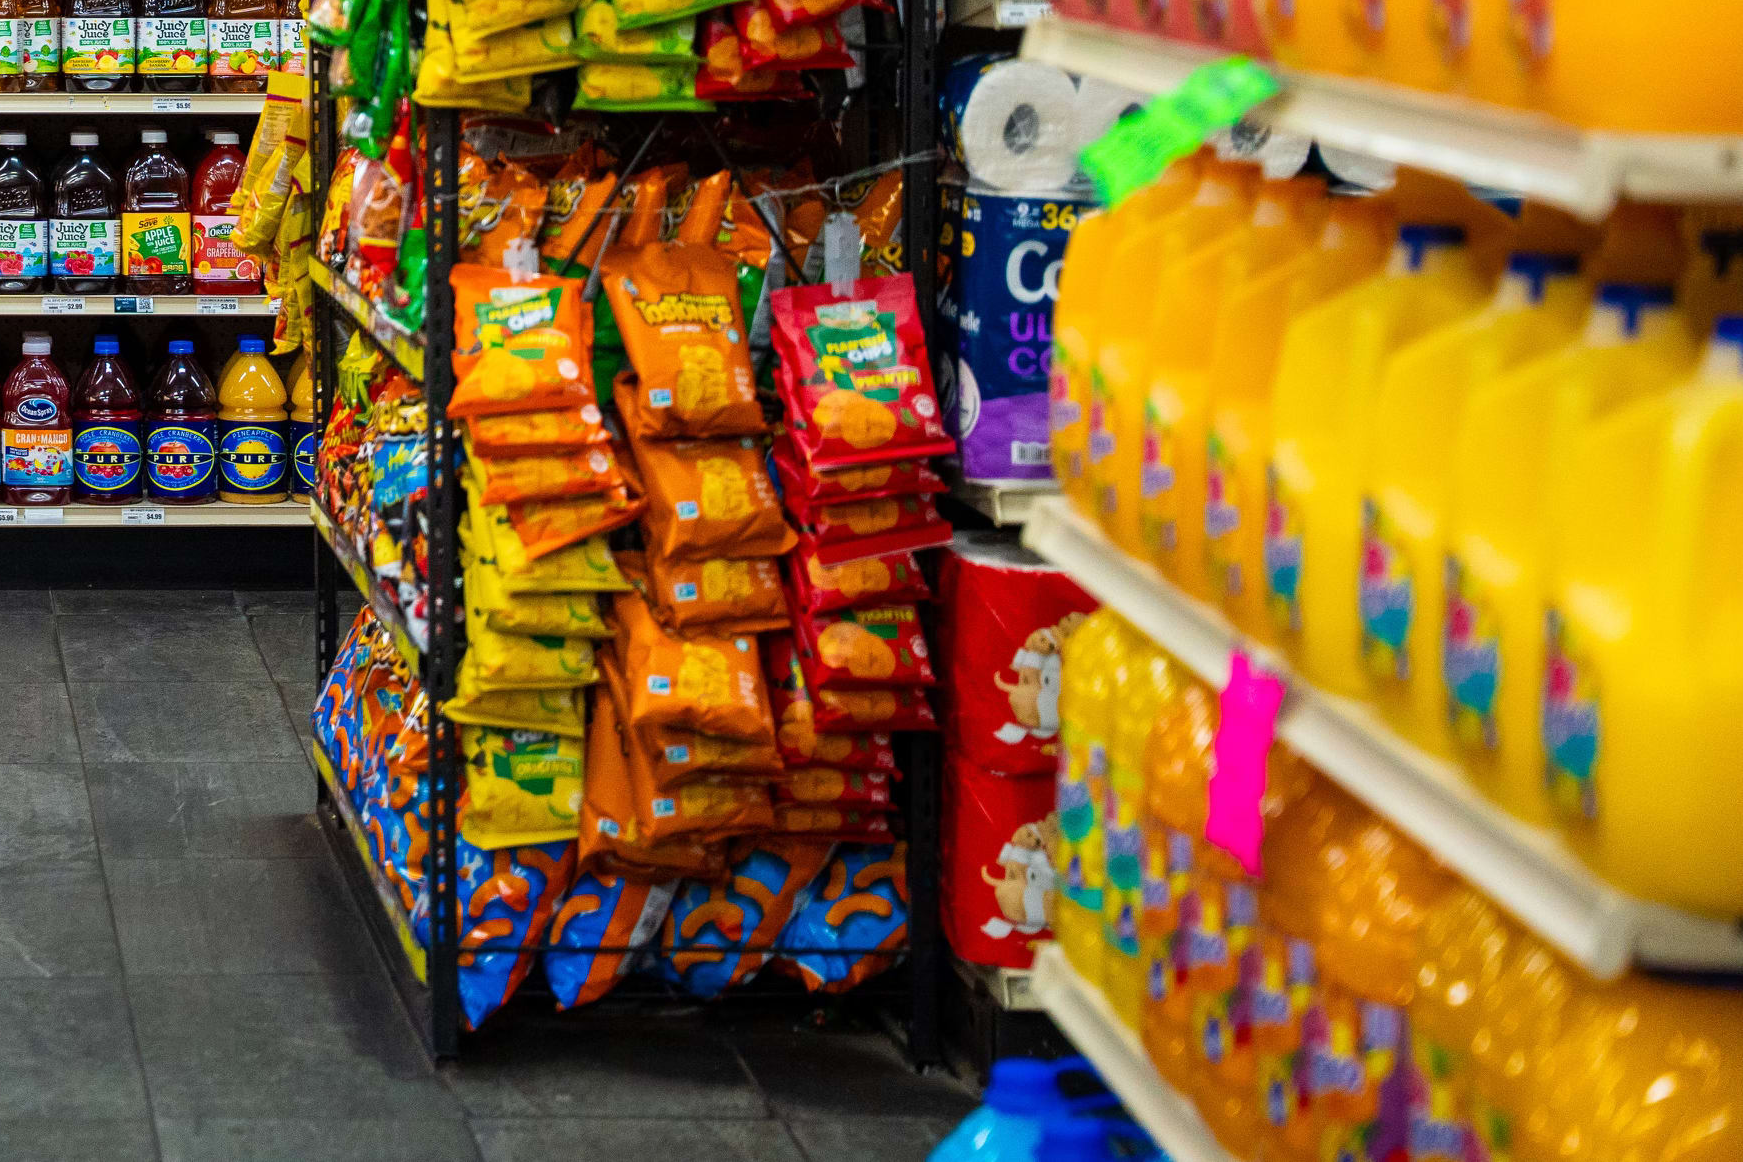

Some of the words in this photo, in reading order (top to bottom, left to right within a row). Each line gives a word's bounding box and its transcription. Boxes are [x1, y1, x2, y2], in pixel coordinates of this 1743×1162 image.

[78, 19, 112, 32] Juicy
[79, 29, 109, 39] Juice
[1040, 203, 1078, 230] 36
[145, 226, 175, 242] APPLE
[154, 237, 175, 249] JUICE
[232, 430, 274, 440] PINEAPPLE
[82, 454, 131, 463] PURE
[153, 454, 201, 463] PURE
[230, 453, 278, 463] PURE
